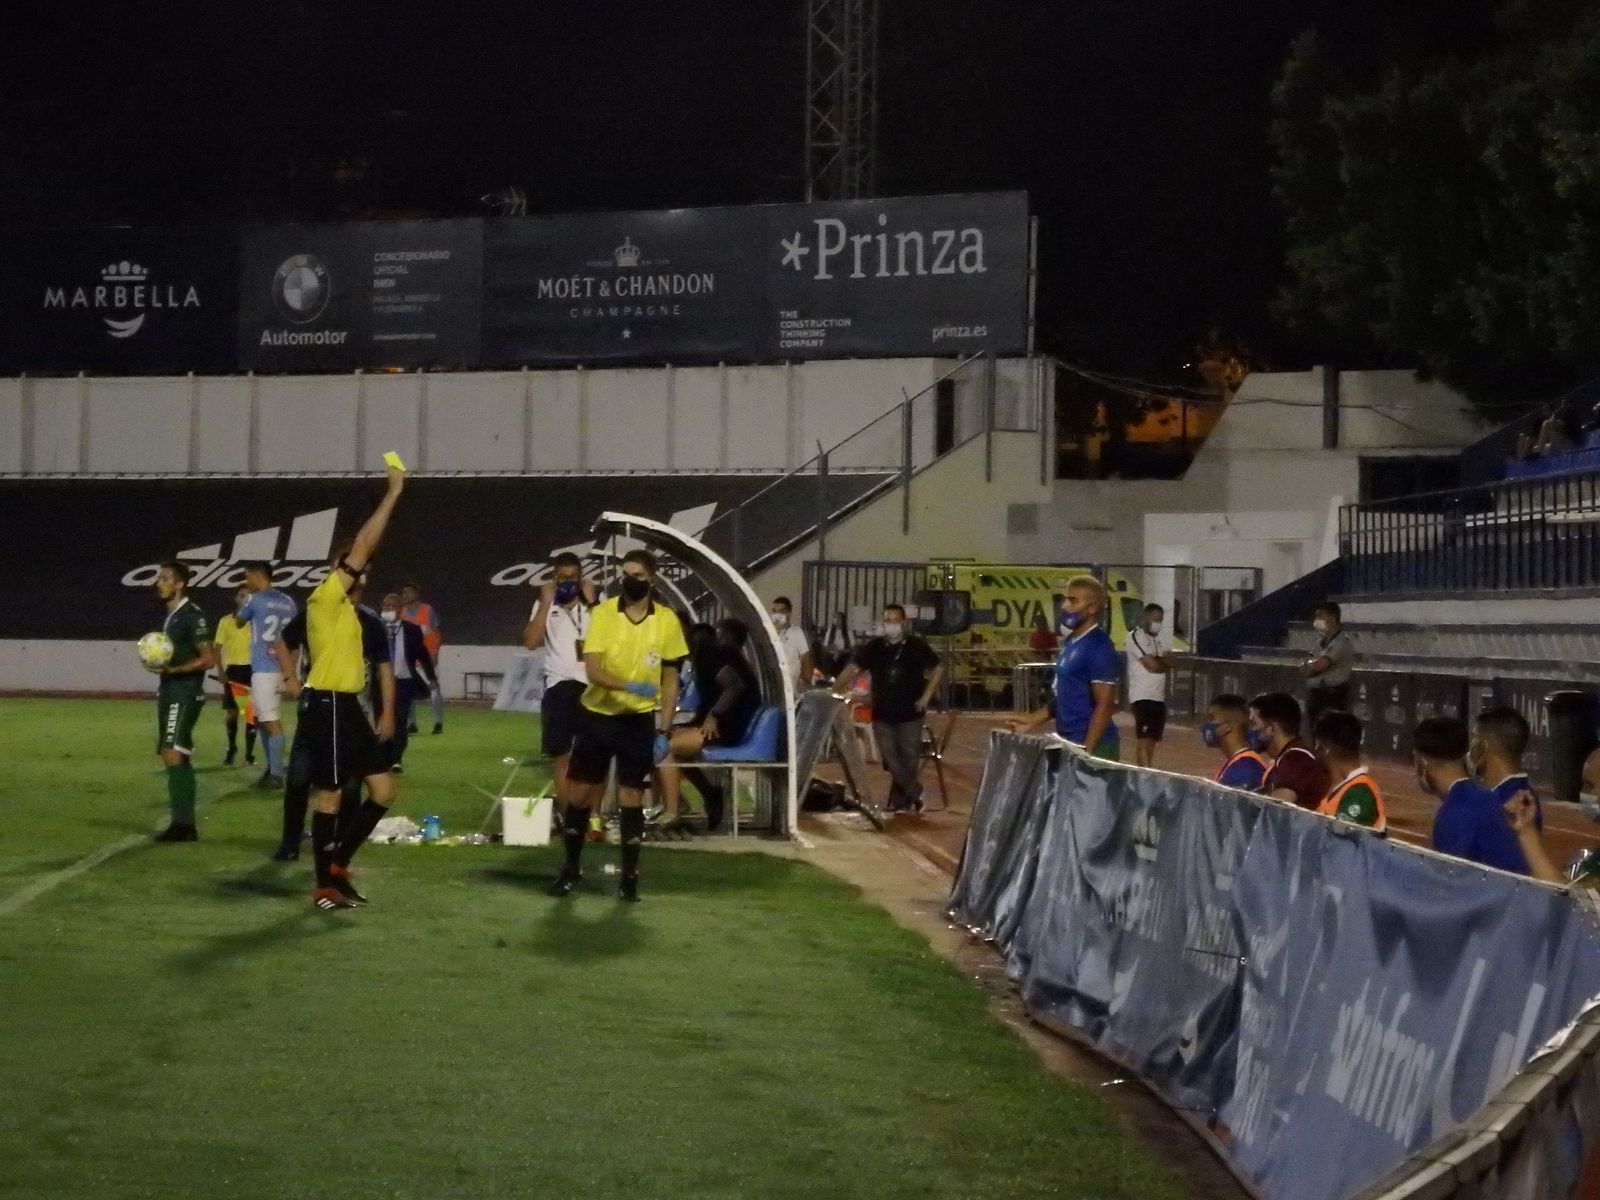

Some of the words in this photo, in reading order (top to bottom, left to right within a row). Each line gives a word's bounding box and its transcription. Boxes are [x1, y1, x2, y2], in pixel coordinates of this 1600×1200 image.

[813, 213, 987, 280] Prinza
[537, 274, 596, 299] MOËT
[599, 280, 611, 297] &
[615, 273, 714, 297] CHANDON
[43, 285, 200, 308] MARBELLA
[569, 304, 681, 319] CHAMPAGNE
[780, 310, 798, 320] THE
[780, 318, 851, 329] CONSTRUCTION
[259, 329, 349, 346] Automotor
[932, 324, 988, 343] prinza.es
[780, 339, 824, 349] COMPANY
[991, 599, 1050, 629] DYA
